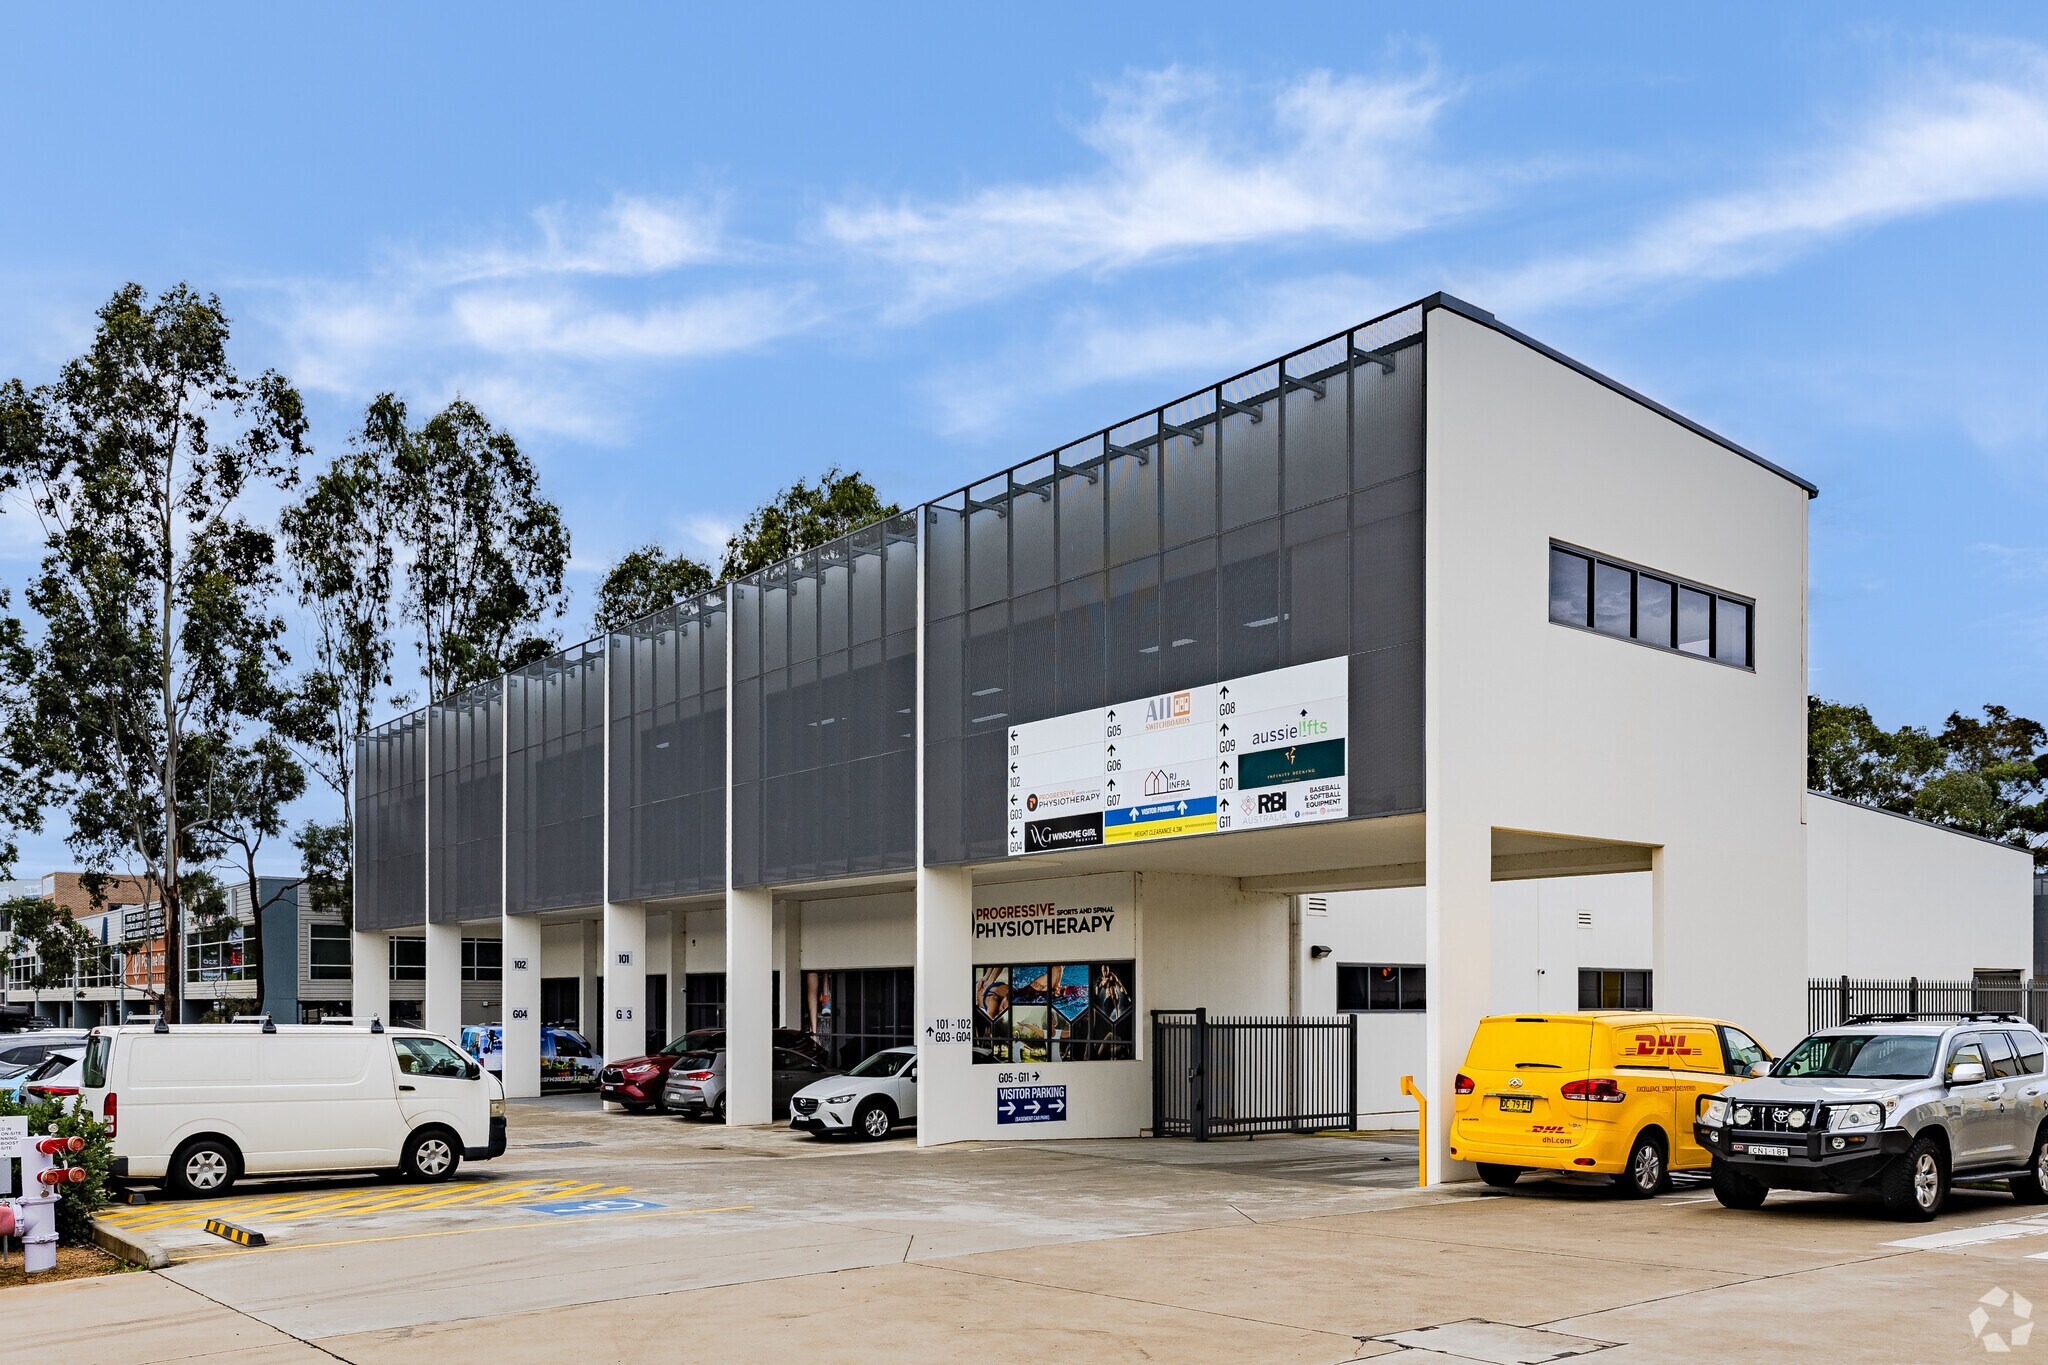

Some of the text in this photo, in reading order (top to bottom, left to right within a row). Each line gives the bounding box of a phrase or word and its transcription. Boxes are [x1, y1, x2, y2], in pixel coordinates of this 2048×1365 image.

[1219, 702, 1236, 716] G08
[1145, 716, 1190, 730] SWITCHBOARDS
[1107, 725, 1122, 738] G05
[1010, 745, 1019, 756] 101
[1219, 740, 1236, 754] G09
[1107, 759, 1122, 772] G06
[1010, 776, 1020, 788] 102
[1169, 780, 1190, 790] INFRA
[1219, 778, 1234, 791] G10
[1039, 789, 1076, 800] PROGRESSIVE
[1310, 784, 1341, 794] BASEBALL
[1039, 792, 1100, 808] PHYSIOTHERAPY
[1107, 794, 1121, 807] G07
[1258, 790, 1286, 814] RBI
[1310, 791, 1341, 801] SOFTBALL
[1306, 799, 1341, 808] EQUIPMENT
[1010, 808, 1022, 820] G03
[1141, 805, 1175, 815] VISITOR PARKING
[1219, 816, 1231, 829] G11
[1243, 812, 1288, 825] AUSTRALIA
[1052, 828, 1097, 841] WINSOME GIRL
[1134, 829, 1149, 838] HEIGHT
[1149, 827, 1172, 836] CLEARANCE
[1010, 842, 1022, 852] G04
[976, 903, 1055, 920] PROGRESSIVE
[1057, 908, 1078, 916] SPORTS
[976, 915, 1115, 938] PHYSIOTHERAPY
[514, 961, 526, 969] 102
[618, 954, 630, 964] 101
[513, 1009, 528, 1018] G04
[936, 1019, 948, 1029] 101
[957, 1019, 971, 1029] 102
[936, 1032, 950, 1042] G03
[956, 1032, 971, 1042] G04
[1635, 1035, 1692, 1055] DHL
[998, 1073, 1013, 1083] G05
[1018, 1072, 1030, 1082] G11
[1000, 1086, 1064, 1100] VISITOR PARKING
[1532, 1125, 1565, 1134] DHL
